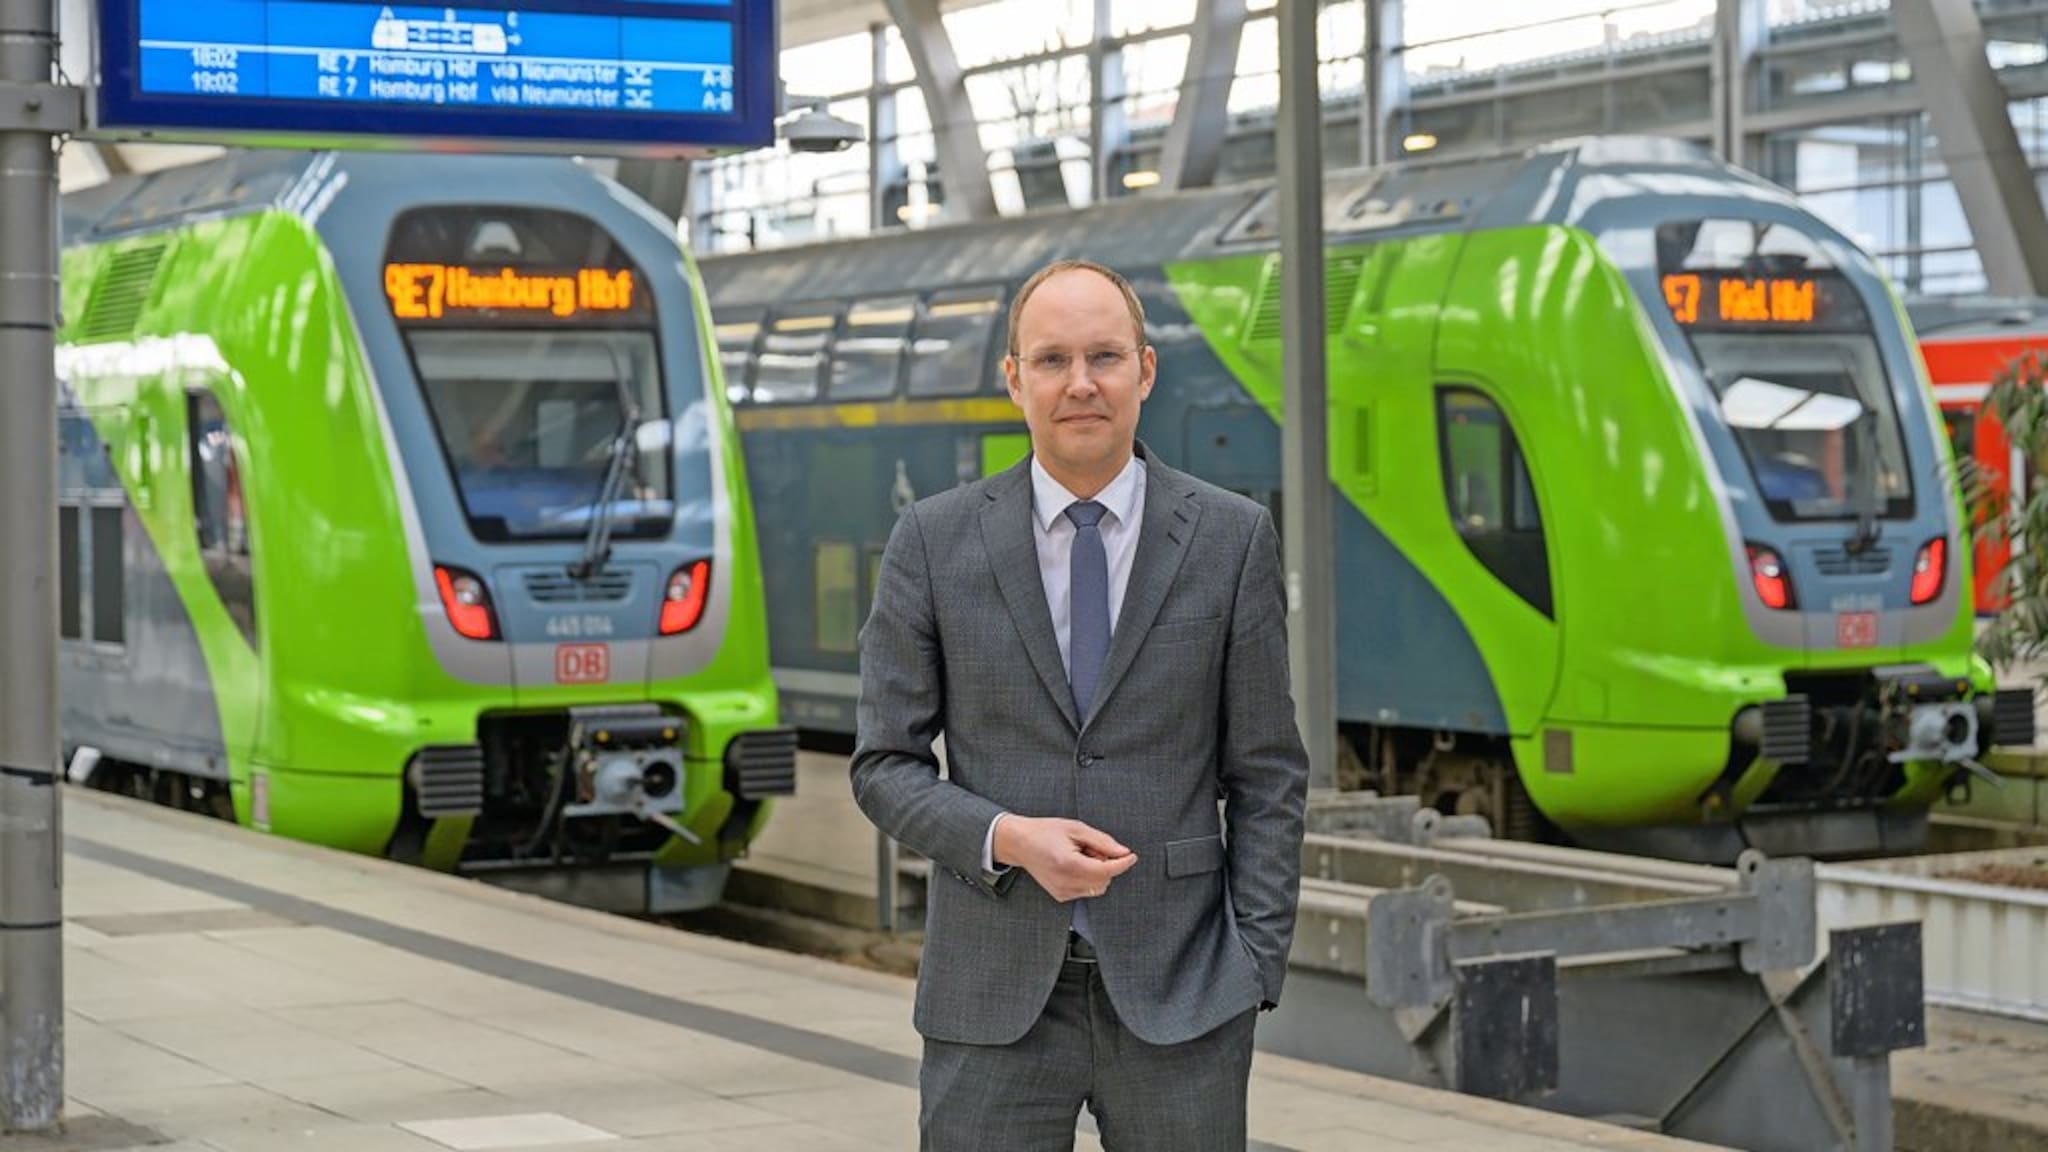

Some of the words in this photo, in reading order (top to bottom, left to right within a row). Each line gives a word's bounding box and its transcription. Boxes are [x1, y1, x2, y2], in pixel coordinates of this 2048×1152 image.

[192, 71, 239, 94] 19:02
[369, 56, 446, 80] Hamburg
[491, 62, 519, 81] via
[318, 75, 341, 97] RE
[345, 76, 358, 96] 7
[369, 78, 446, 104] Hamburg
[449, 82, 478, 101] Hbf
[491, 85, 519, 103] via
[521, 84, 620, 107] Neumünster
[446, 266, 576, 317] Hamburg
[577, 268, 632, 309] Hbf
[561, 648, 603, 679] DB
